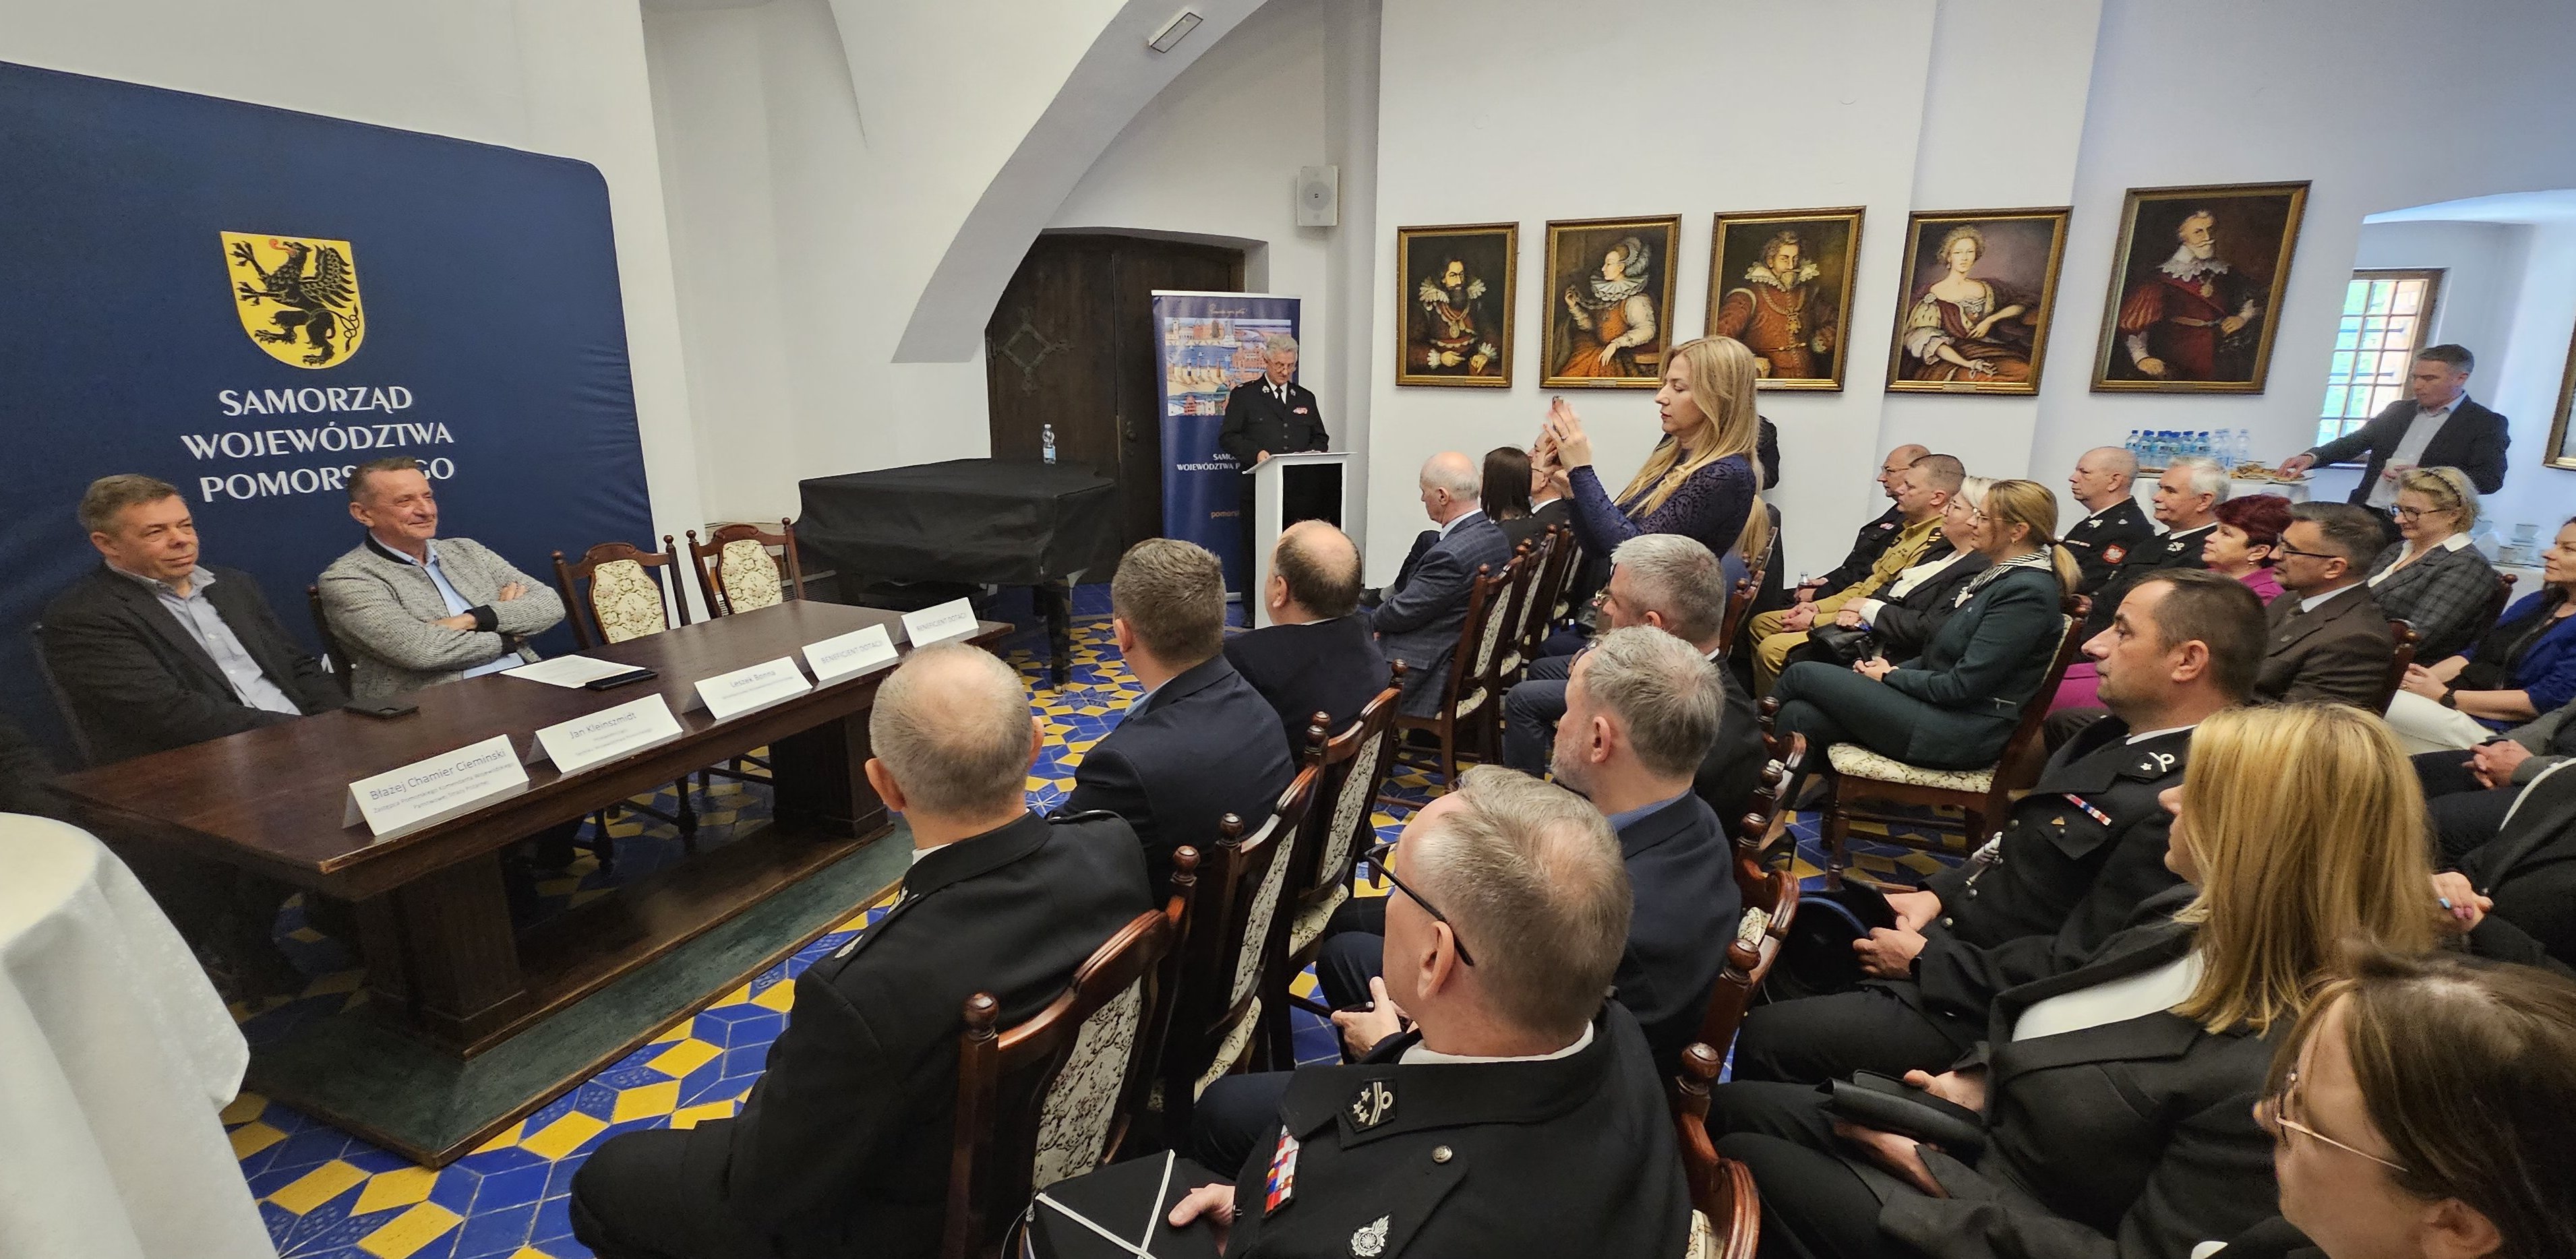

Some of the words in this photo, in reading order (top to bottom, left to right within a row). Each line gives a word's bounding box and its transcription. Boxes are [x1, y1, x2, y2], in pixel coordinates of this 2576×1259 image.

[218, 386, 413, 417] SAMORZĄD
[181, 421, 454, 460] WOJEWÓDZTWA
[1176, 462, 1234, 470] WOJEWÓDZTWA
[569, 728, 585, 739] Jan
[586, 712, 636, 733] Kleinszmidt
[369, 781, 407, 800] Błażej
[408, 768, 453, 787] Chamier
